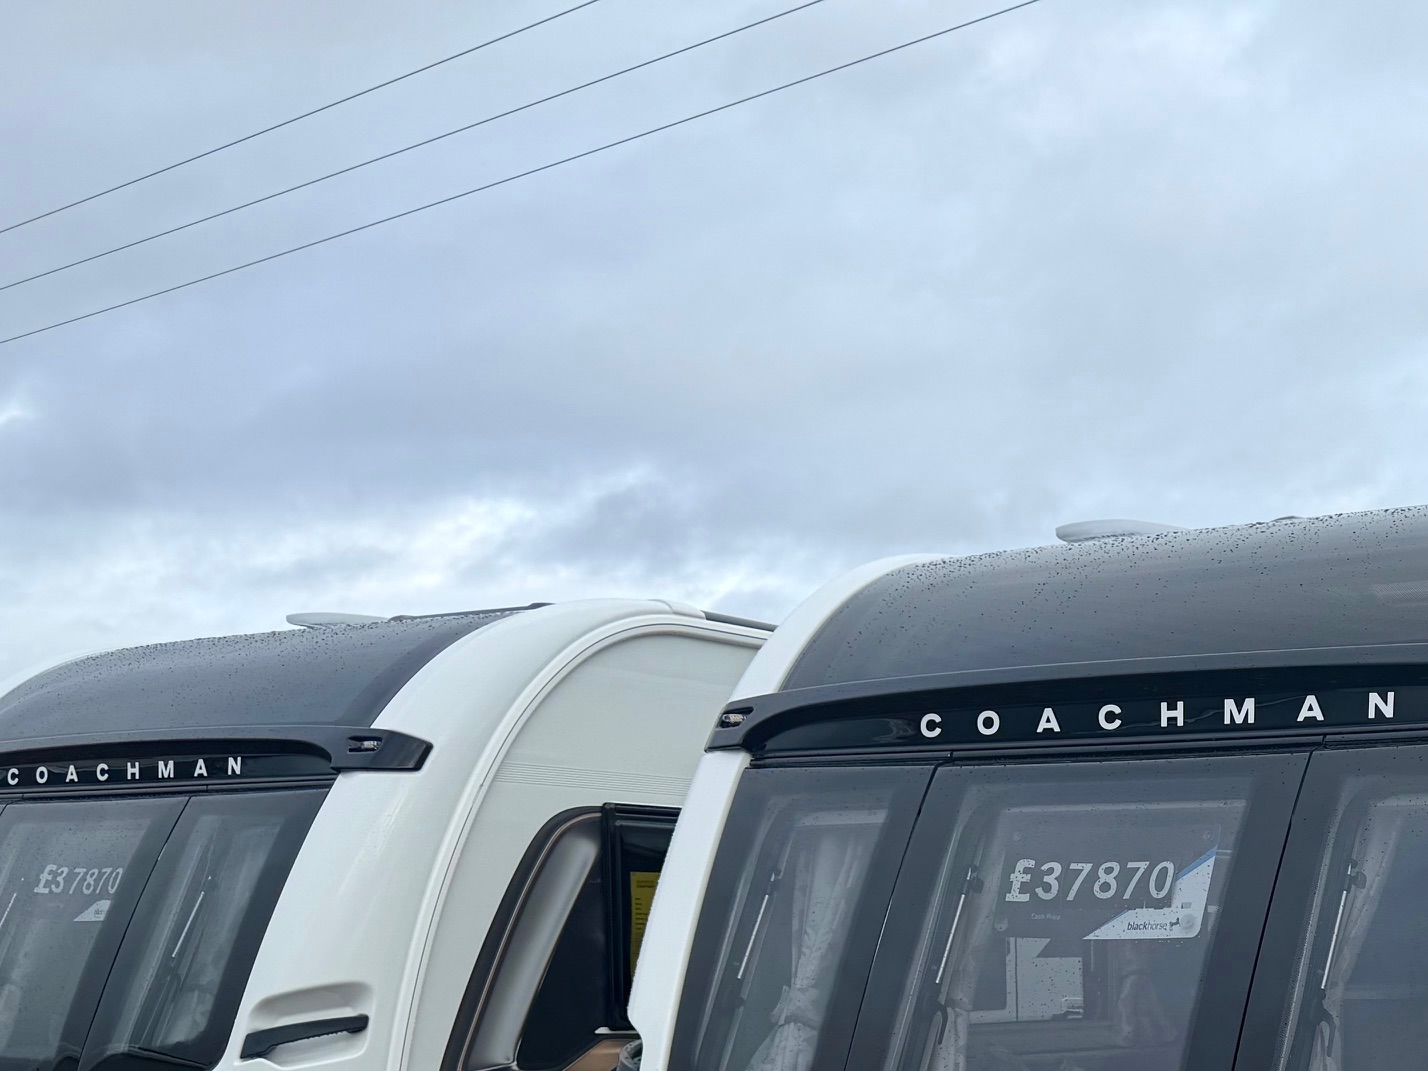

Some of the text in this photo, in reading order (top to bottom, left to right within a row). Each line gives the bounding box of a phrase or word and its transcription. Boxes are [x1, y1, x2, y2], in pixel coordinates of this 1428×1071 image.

[919, 691, 1395, 738] COACHMAN
[7, 756, 242, 785] COACHMAN
[33, 864, 123, 895] £37870
[1005, 858, 1175, 902] £37870
[1126, 921, 1168, 931] blackhorse
